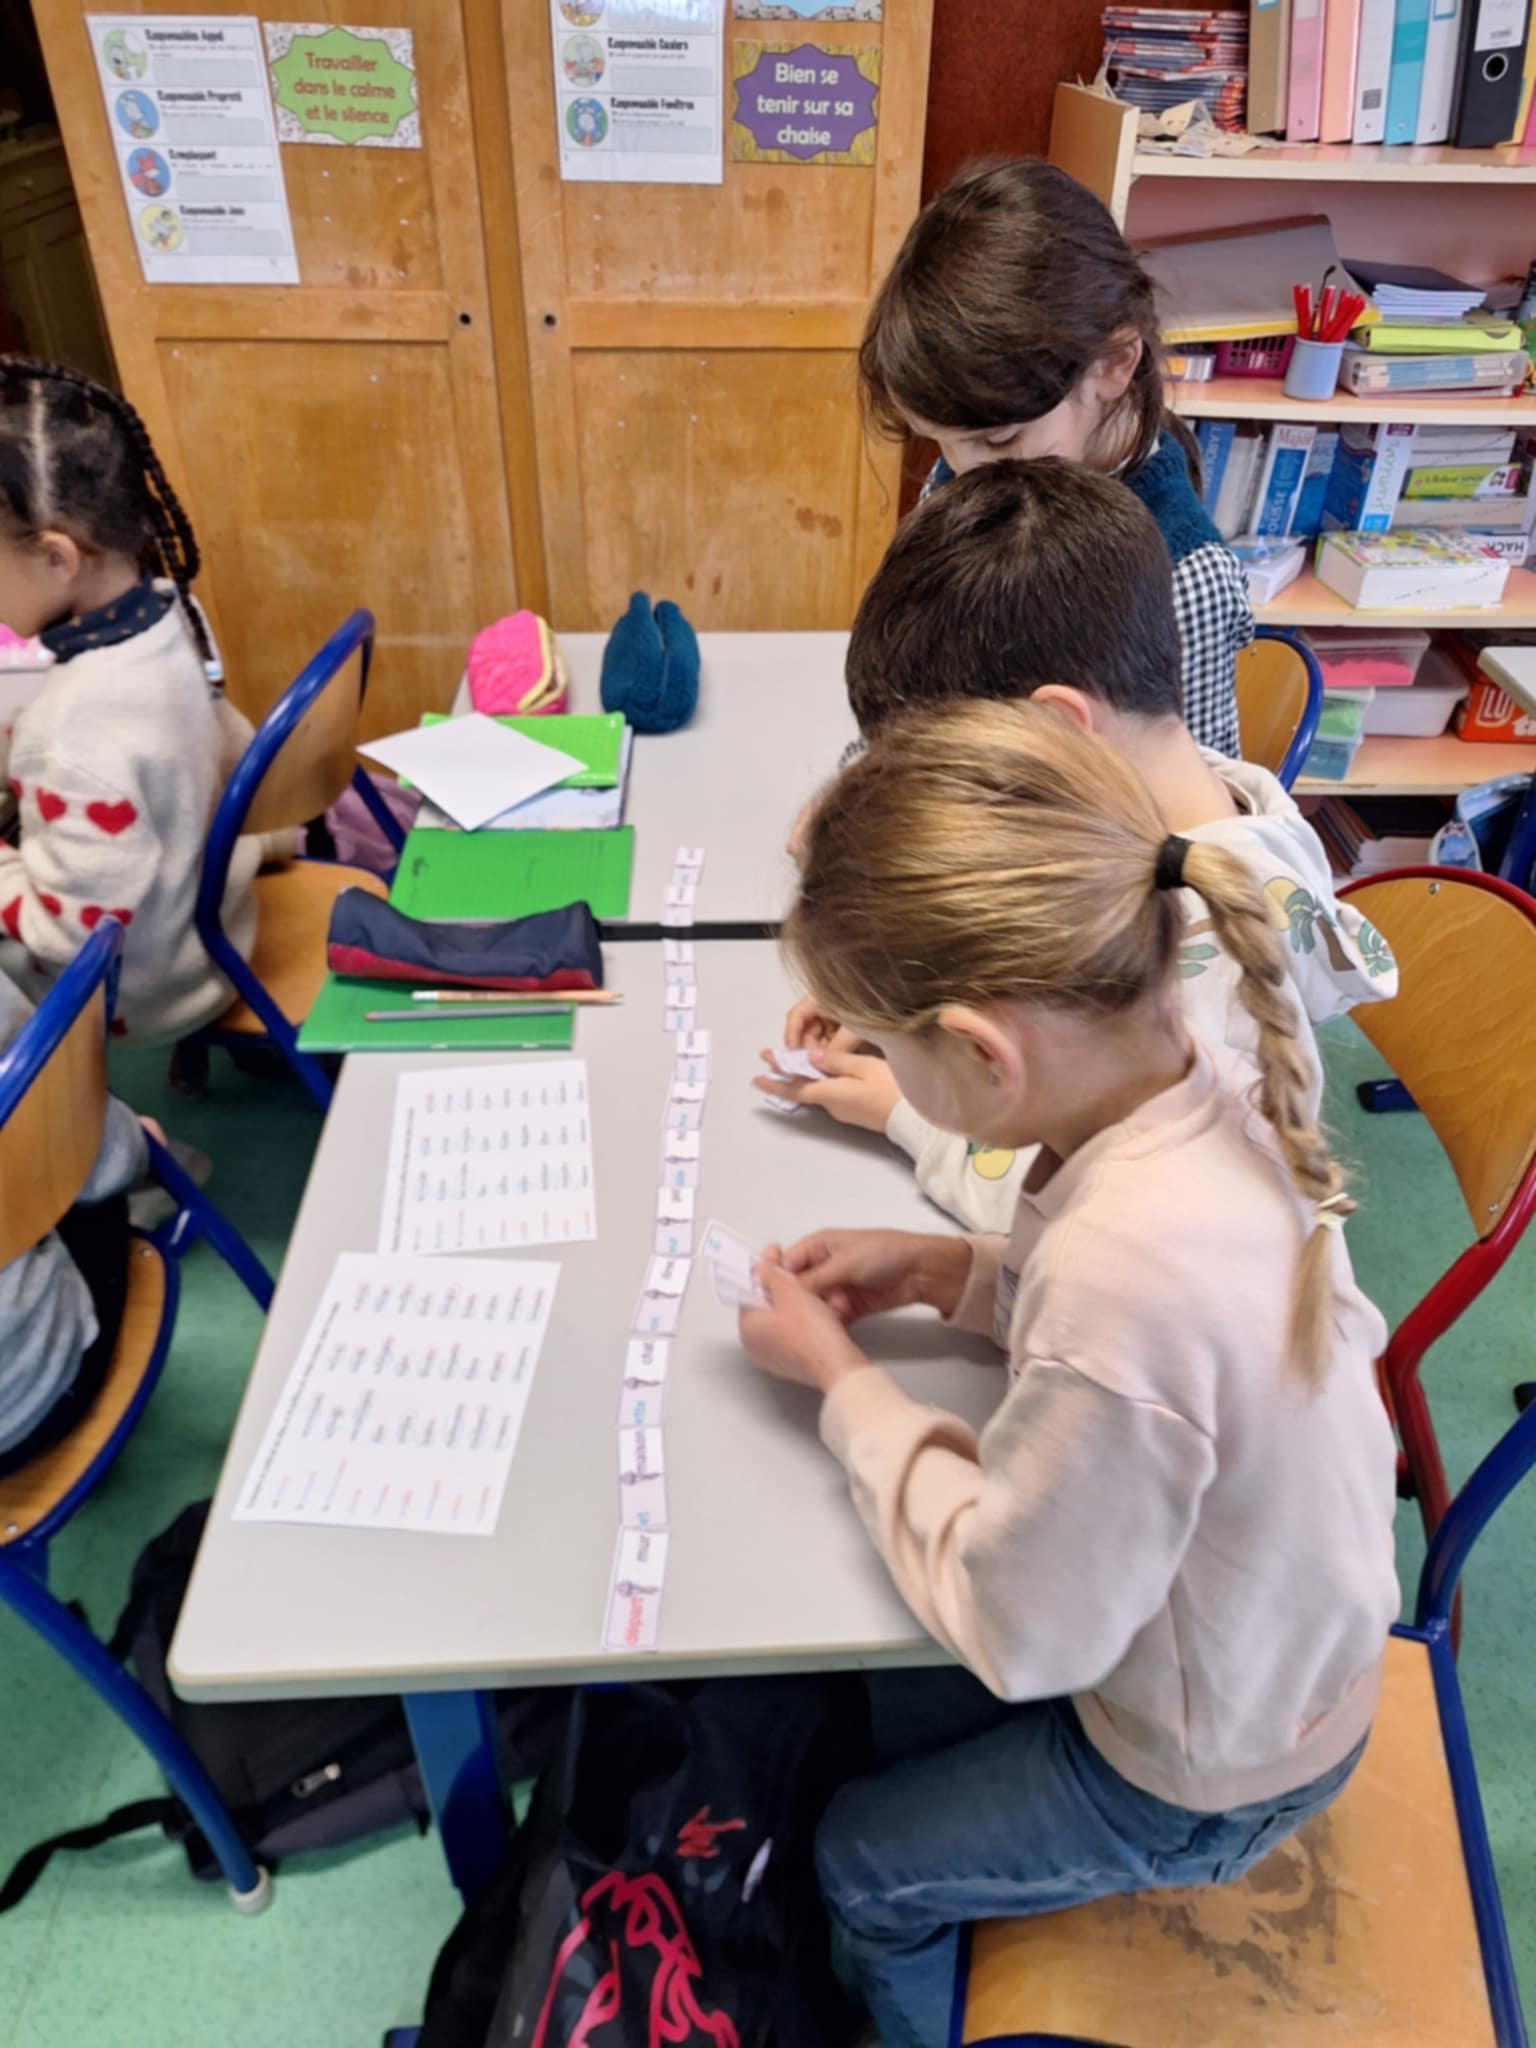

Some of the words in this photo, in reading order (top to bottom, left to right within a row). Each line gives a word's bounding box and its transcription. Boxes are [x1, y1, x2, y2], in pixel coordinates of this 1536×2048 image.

[304, 51, 377, 72] Travailler
[775, 61, 816, 84] Bien
[820, 68, 839, 85] se
[294, 78, 328, 96] dans
[332, 80, 346, 97] le
[350, 82, 395, 99] calme
[305, 105, 320, 120] et
[323, 104, 338, 121] le
[341, 105, 388, 124] silence
[757, 94, 799, 114] tenir
[803, 99, 831, 115] sur
[834, 100, 855, 117] sa
[777, 124, 832, 146] chaise
[1482, 689, 1511, 719] LU
[636, 1533, 651, 1563] mur
